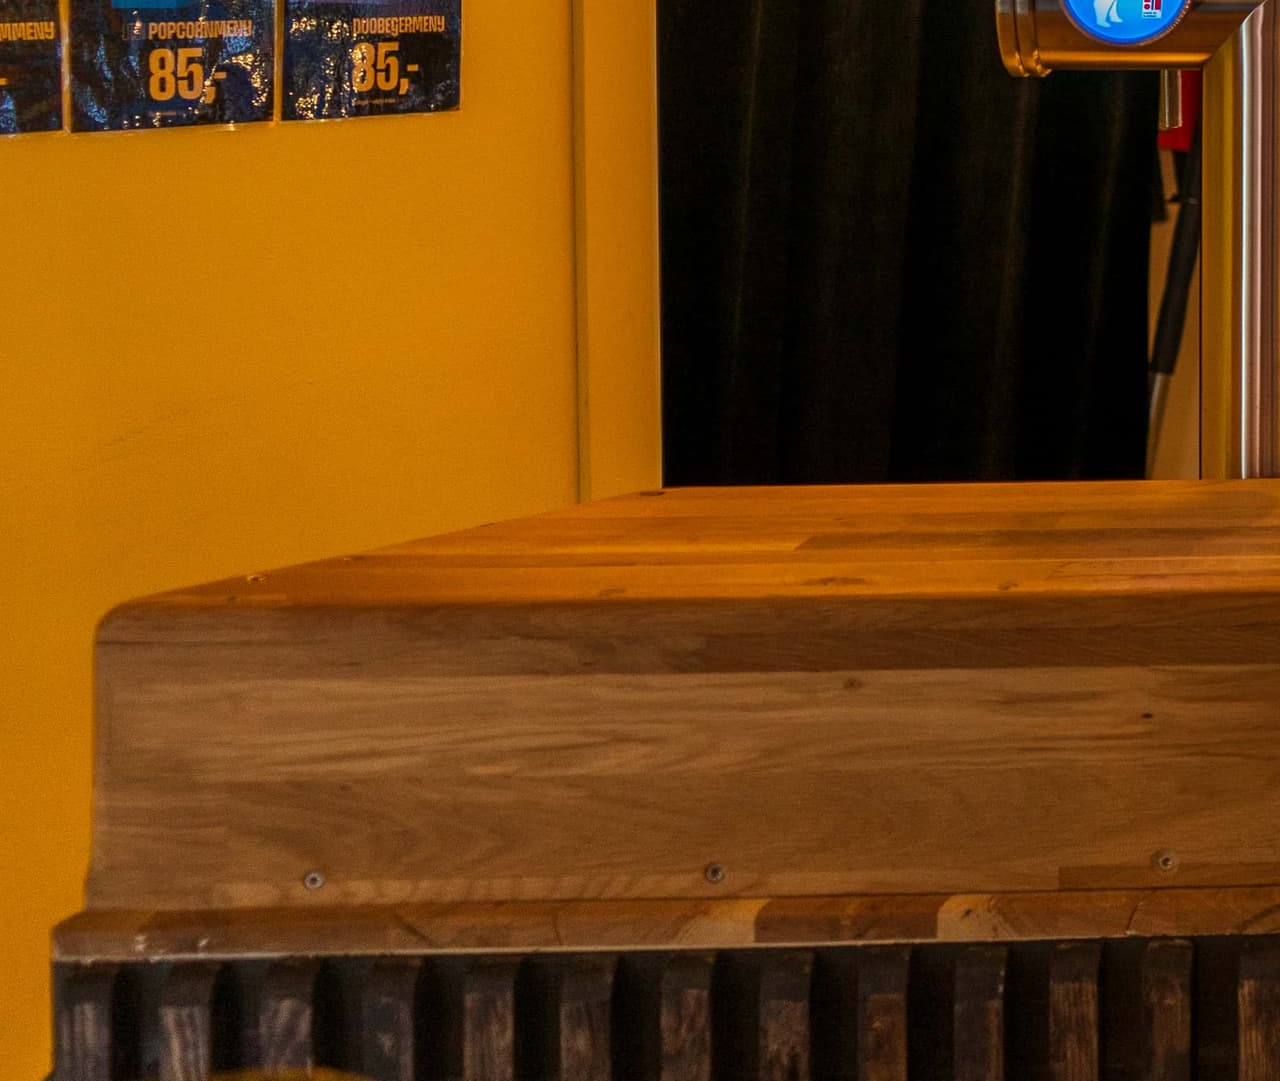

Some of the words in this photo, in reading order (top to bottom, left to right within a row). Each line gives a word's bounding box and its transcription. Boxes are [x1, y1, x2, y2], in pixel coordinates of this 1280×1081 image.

[353, 15, 446, 36] DUOBEGERMENY
[149, 46, 228, 105] 85,-
[351, 40, 419, 96] 85,-
